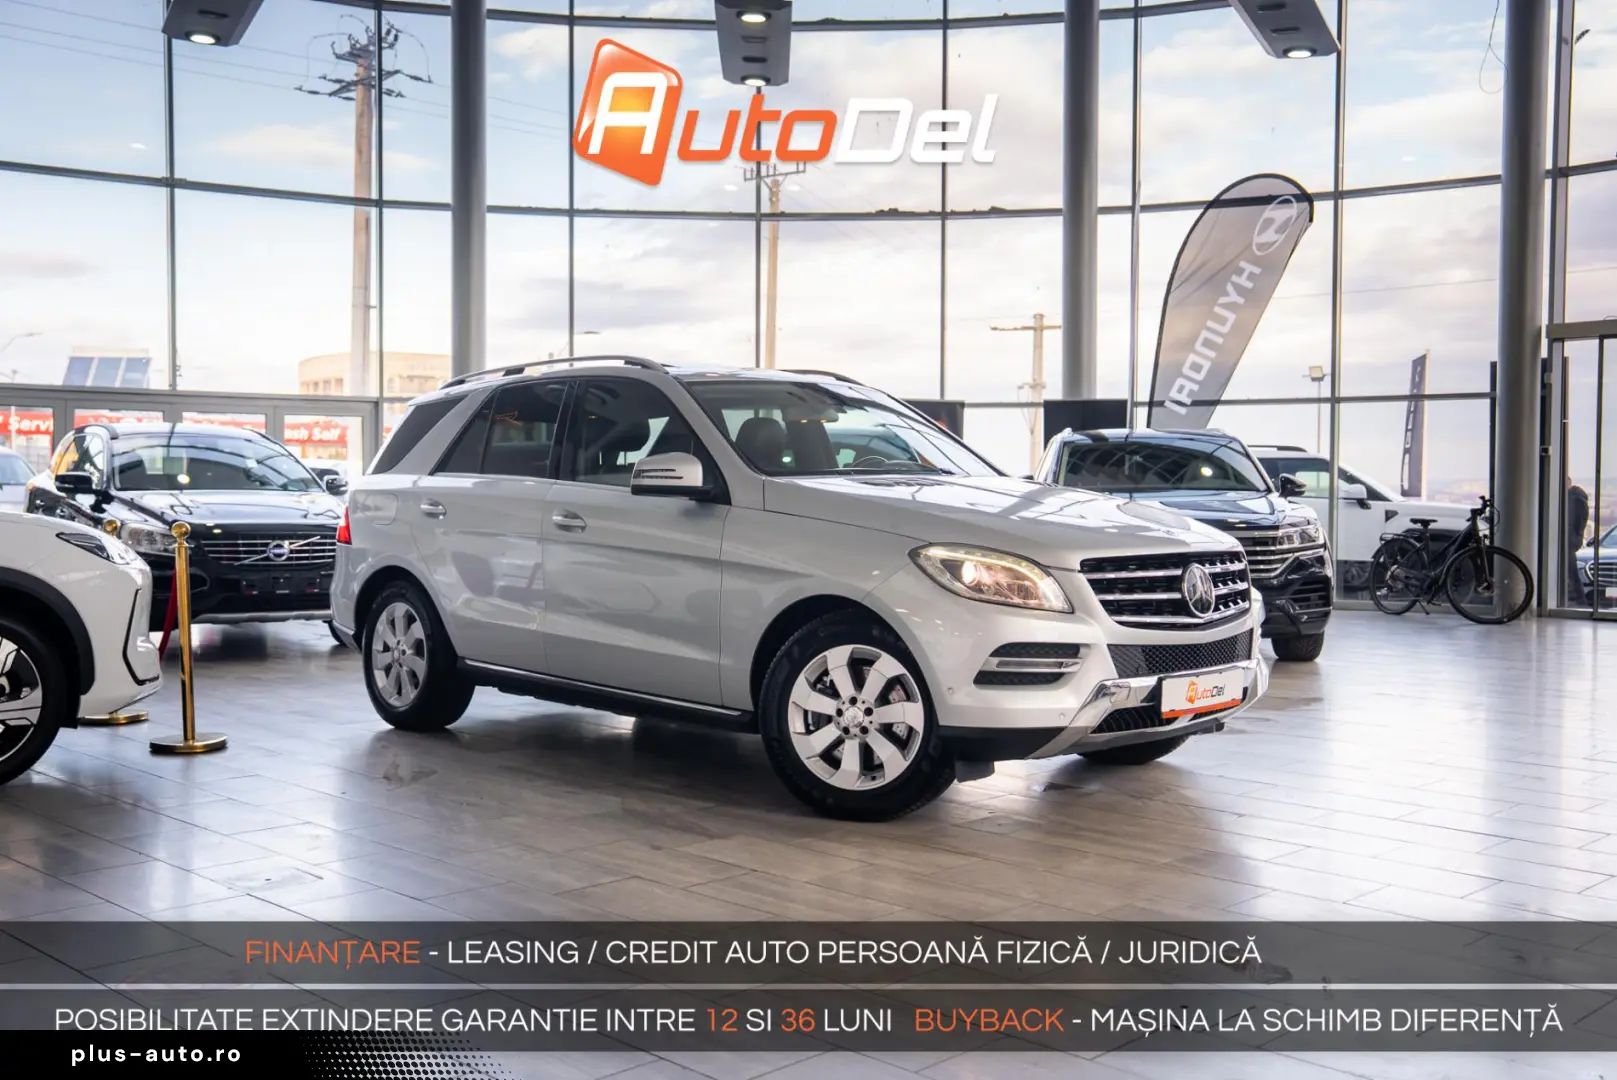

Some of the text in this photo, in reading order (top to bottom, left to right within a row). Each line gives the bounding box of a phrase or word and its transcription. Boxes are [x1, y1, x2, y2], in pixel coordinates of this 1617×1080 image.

[8, 416, 53, 431] Servi
[284, 427, 309, 441] ash
[1186, 682, 1225, 702] AutoDel
